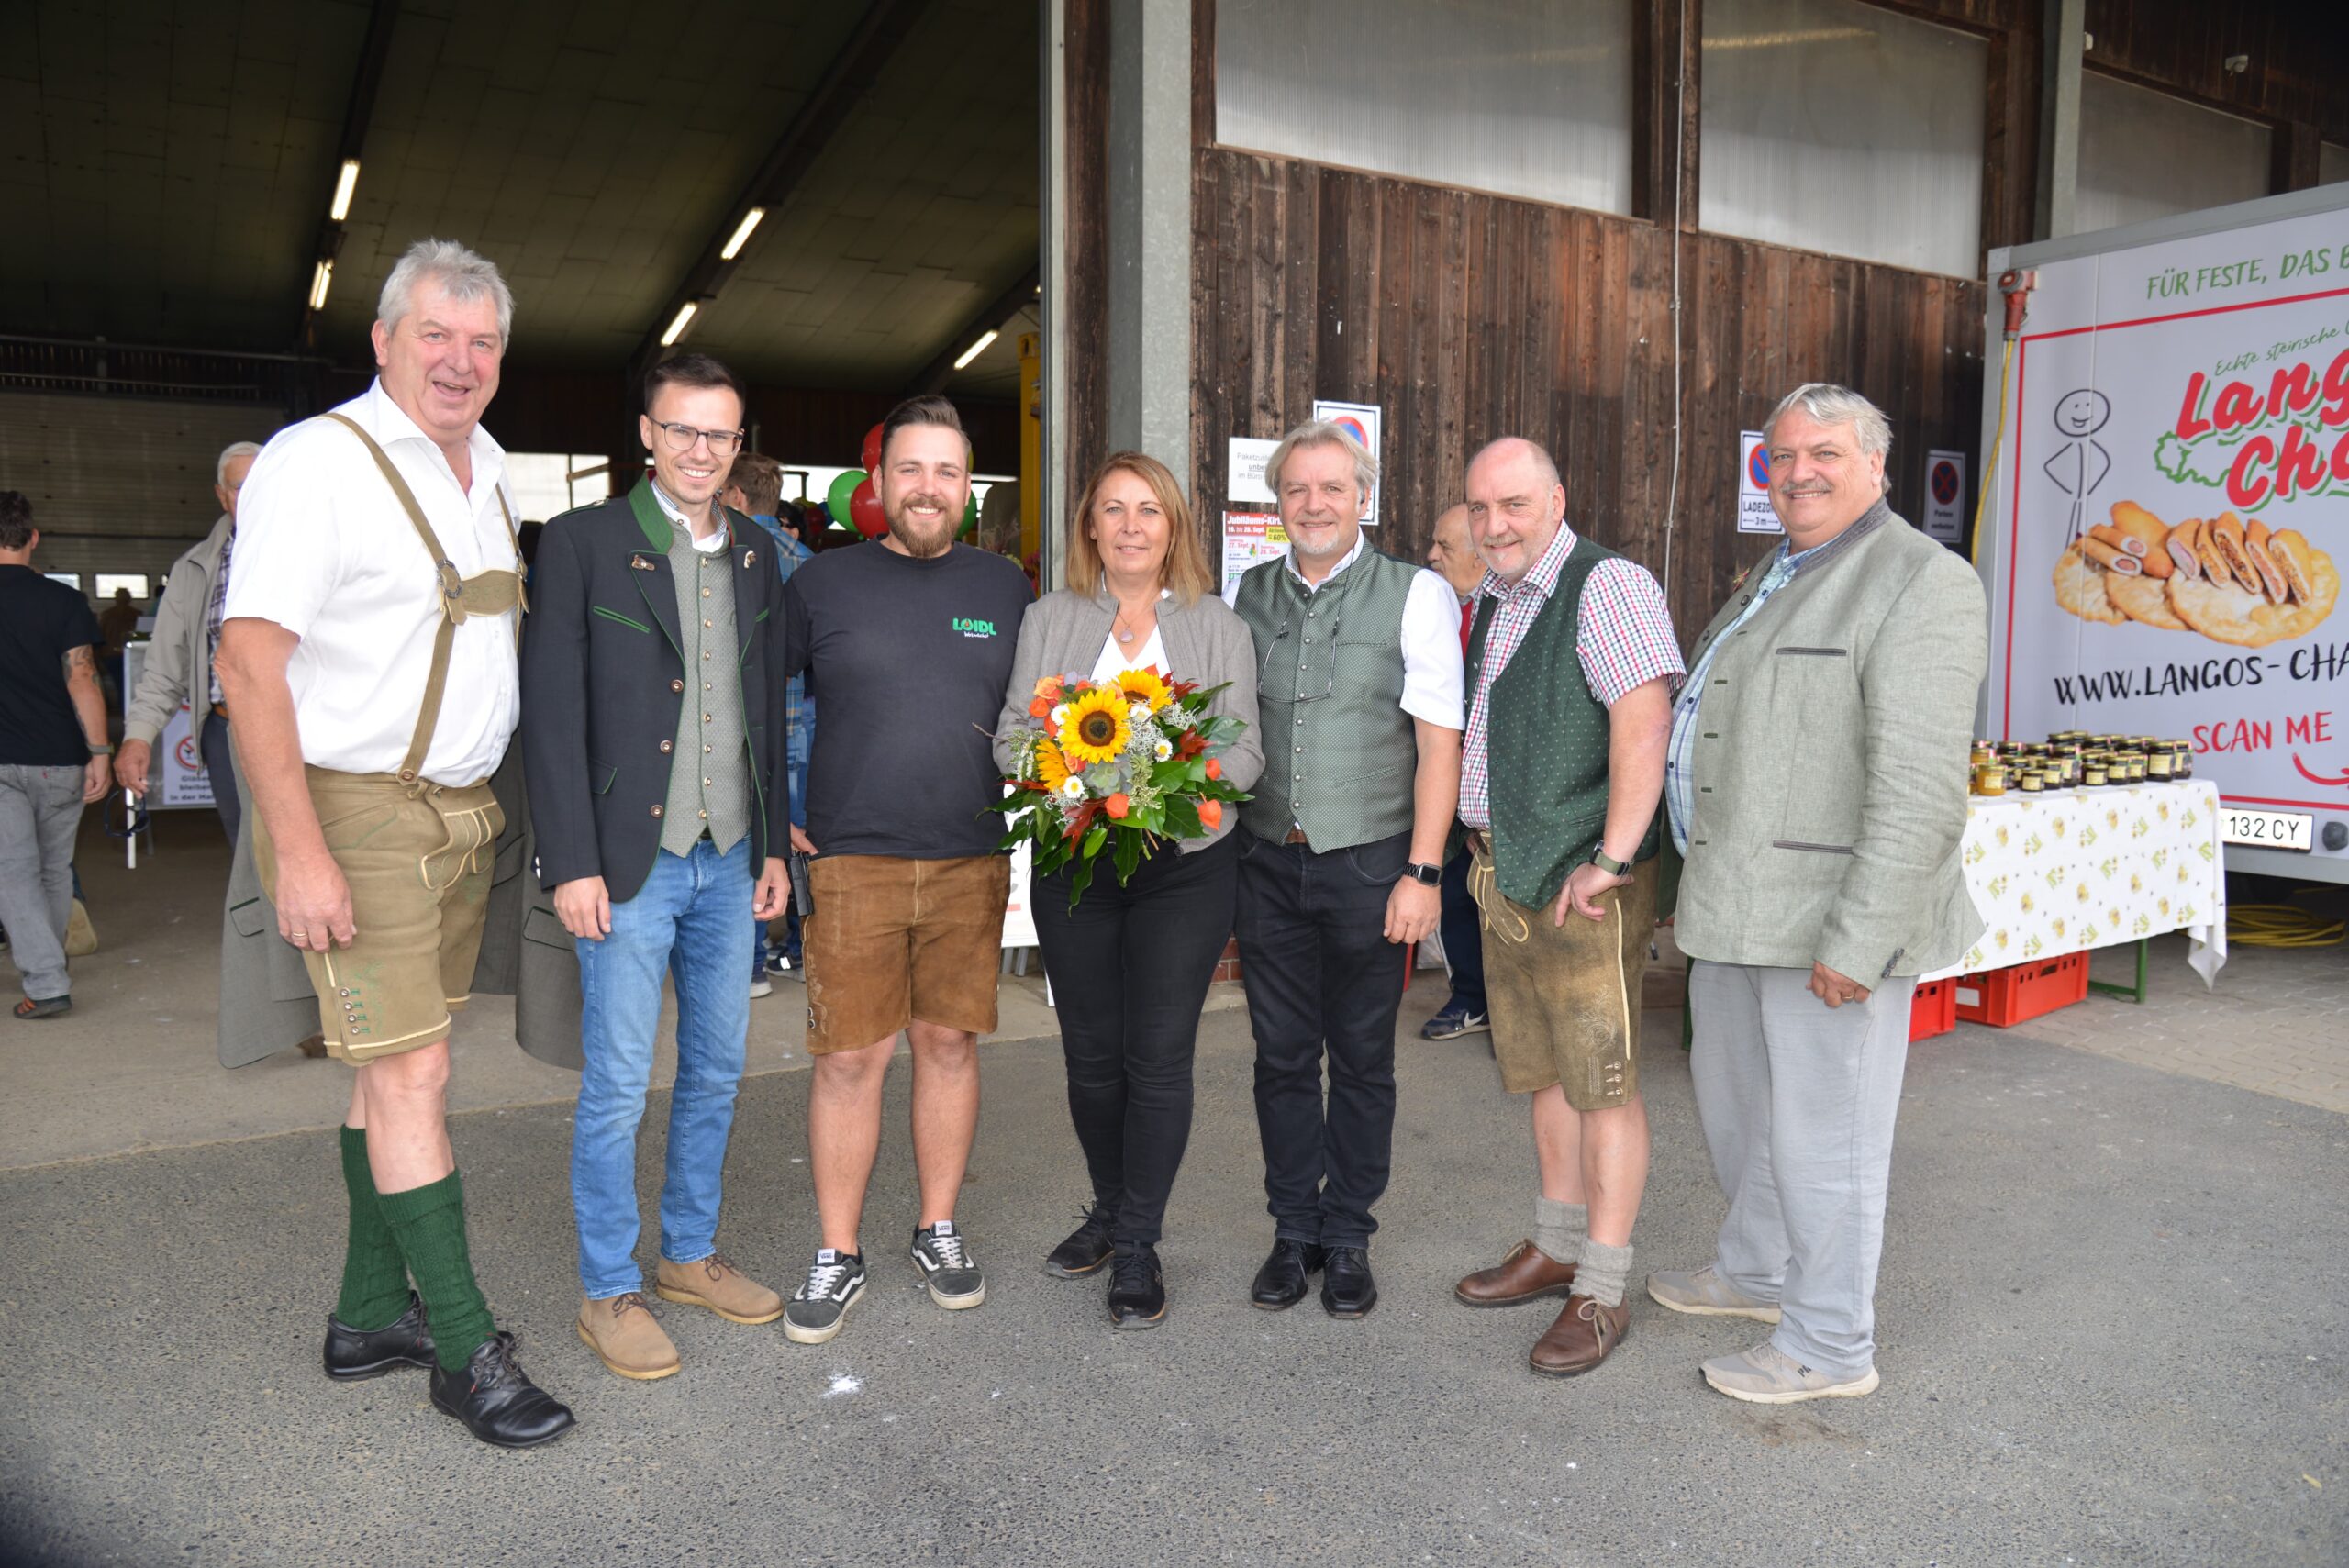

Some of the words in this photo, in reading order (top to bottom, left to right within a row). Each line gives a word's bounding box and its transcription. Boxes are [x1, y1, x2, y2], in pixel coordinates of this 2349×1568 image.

[2147, 268, 2189, 300] FÜR
[2196, 259, 2267, 293] FESTE,
[2279, 248, 2331, 279] DAS
[2214, 351, 2259, 376] Echte
[2266, 327, 2340, 361] steirische
[952, 617, 996, 636] LOIDL
[2192, 718, 2272, 754] SCAN
[2286, 711, 2332, 744] ME
[2230, 816, 2265, 839] 132
[2273, 819, 2299, 841] CY
